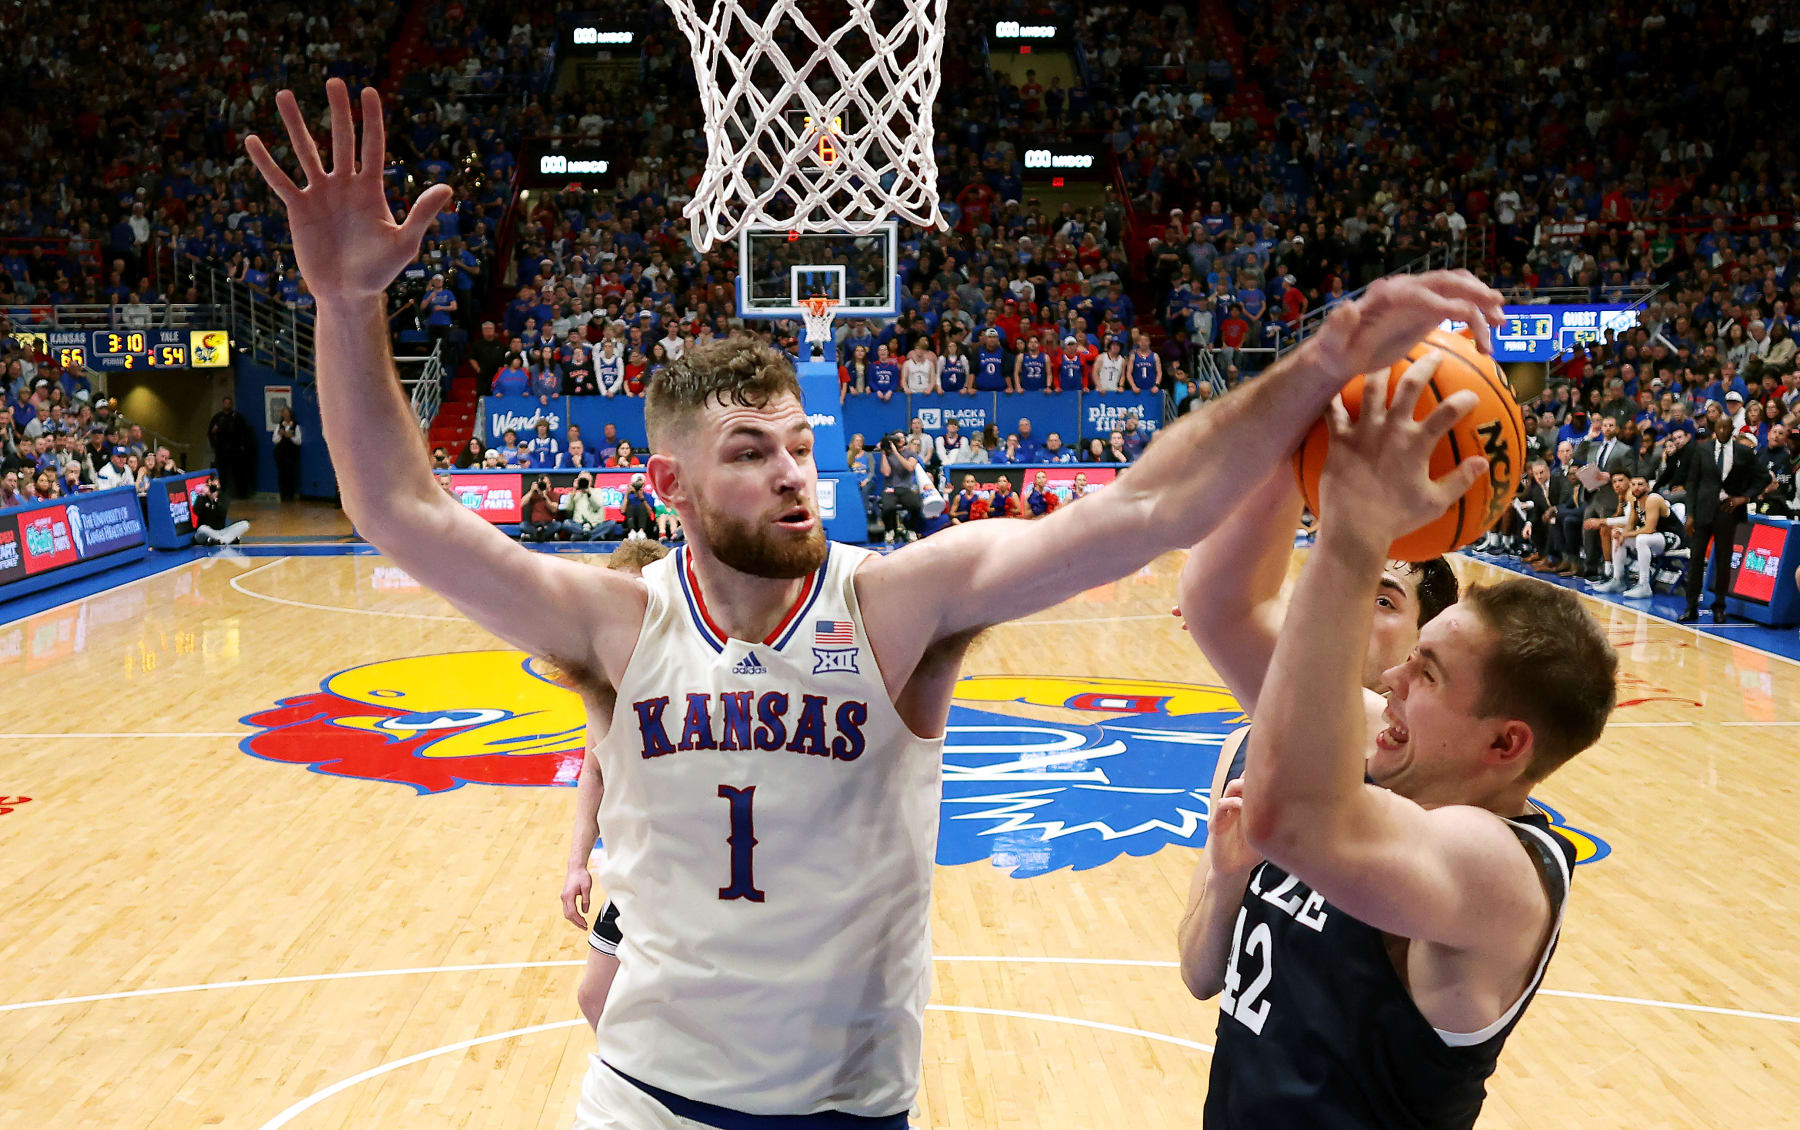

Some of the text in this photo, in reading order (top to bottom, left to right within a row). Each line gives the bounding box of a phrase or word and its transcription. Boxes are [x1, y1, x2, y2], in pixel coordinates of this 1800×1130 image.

[1563, 311, 1598, 326] GUEST
[50, 332, 87, 344] KANSAS
[108, 333, 143, 353] 3:10
[160, 331, 180, 342] YALE
[124, 354, 134, 369] 2
[163, 346, 184, 365] 54
[1027, 366, 1042, 378] 22
[944, 409, 986, 418] BLACK &
[492, 407, 560, 438] Wend's
[945, 418, 985, 427] ATCH
[487, 489, 512, 499] AUTO
[484, 499, 515, 510] PARTS
[732, 666, 767, 675] adidas
[633, 690, 868, 761] KANSAS
[718, 784, 765, 903] 1
[1220, 905, 1273, 1036] 42
